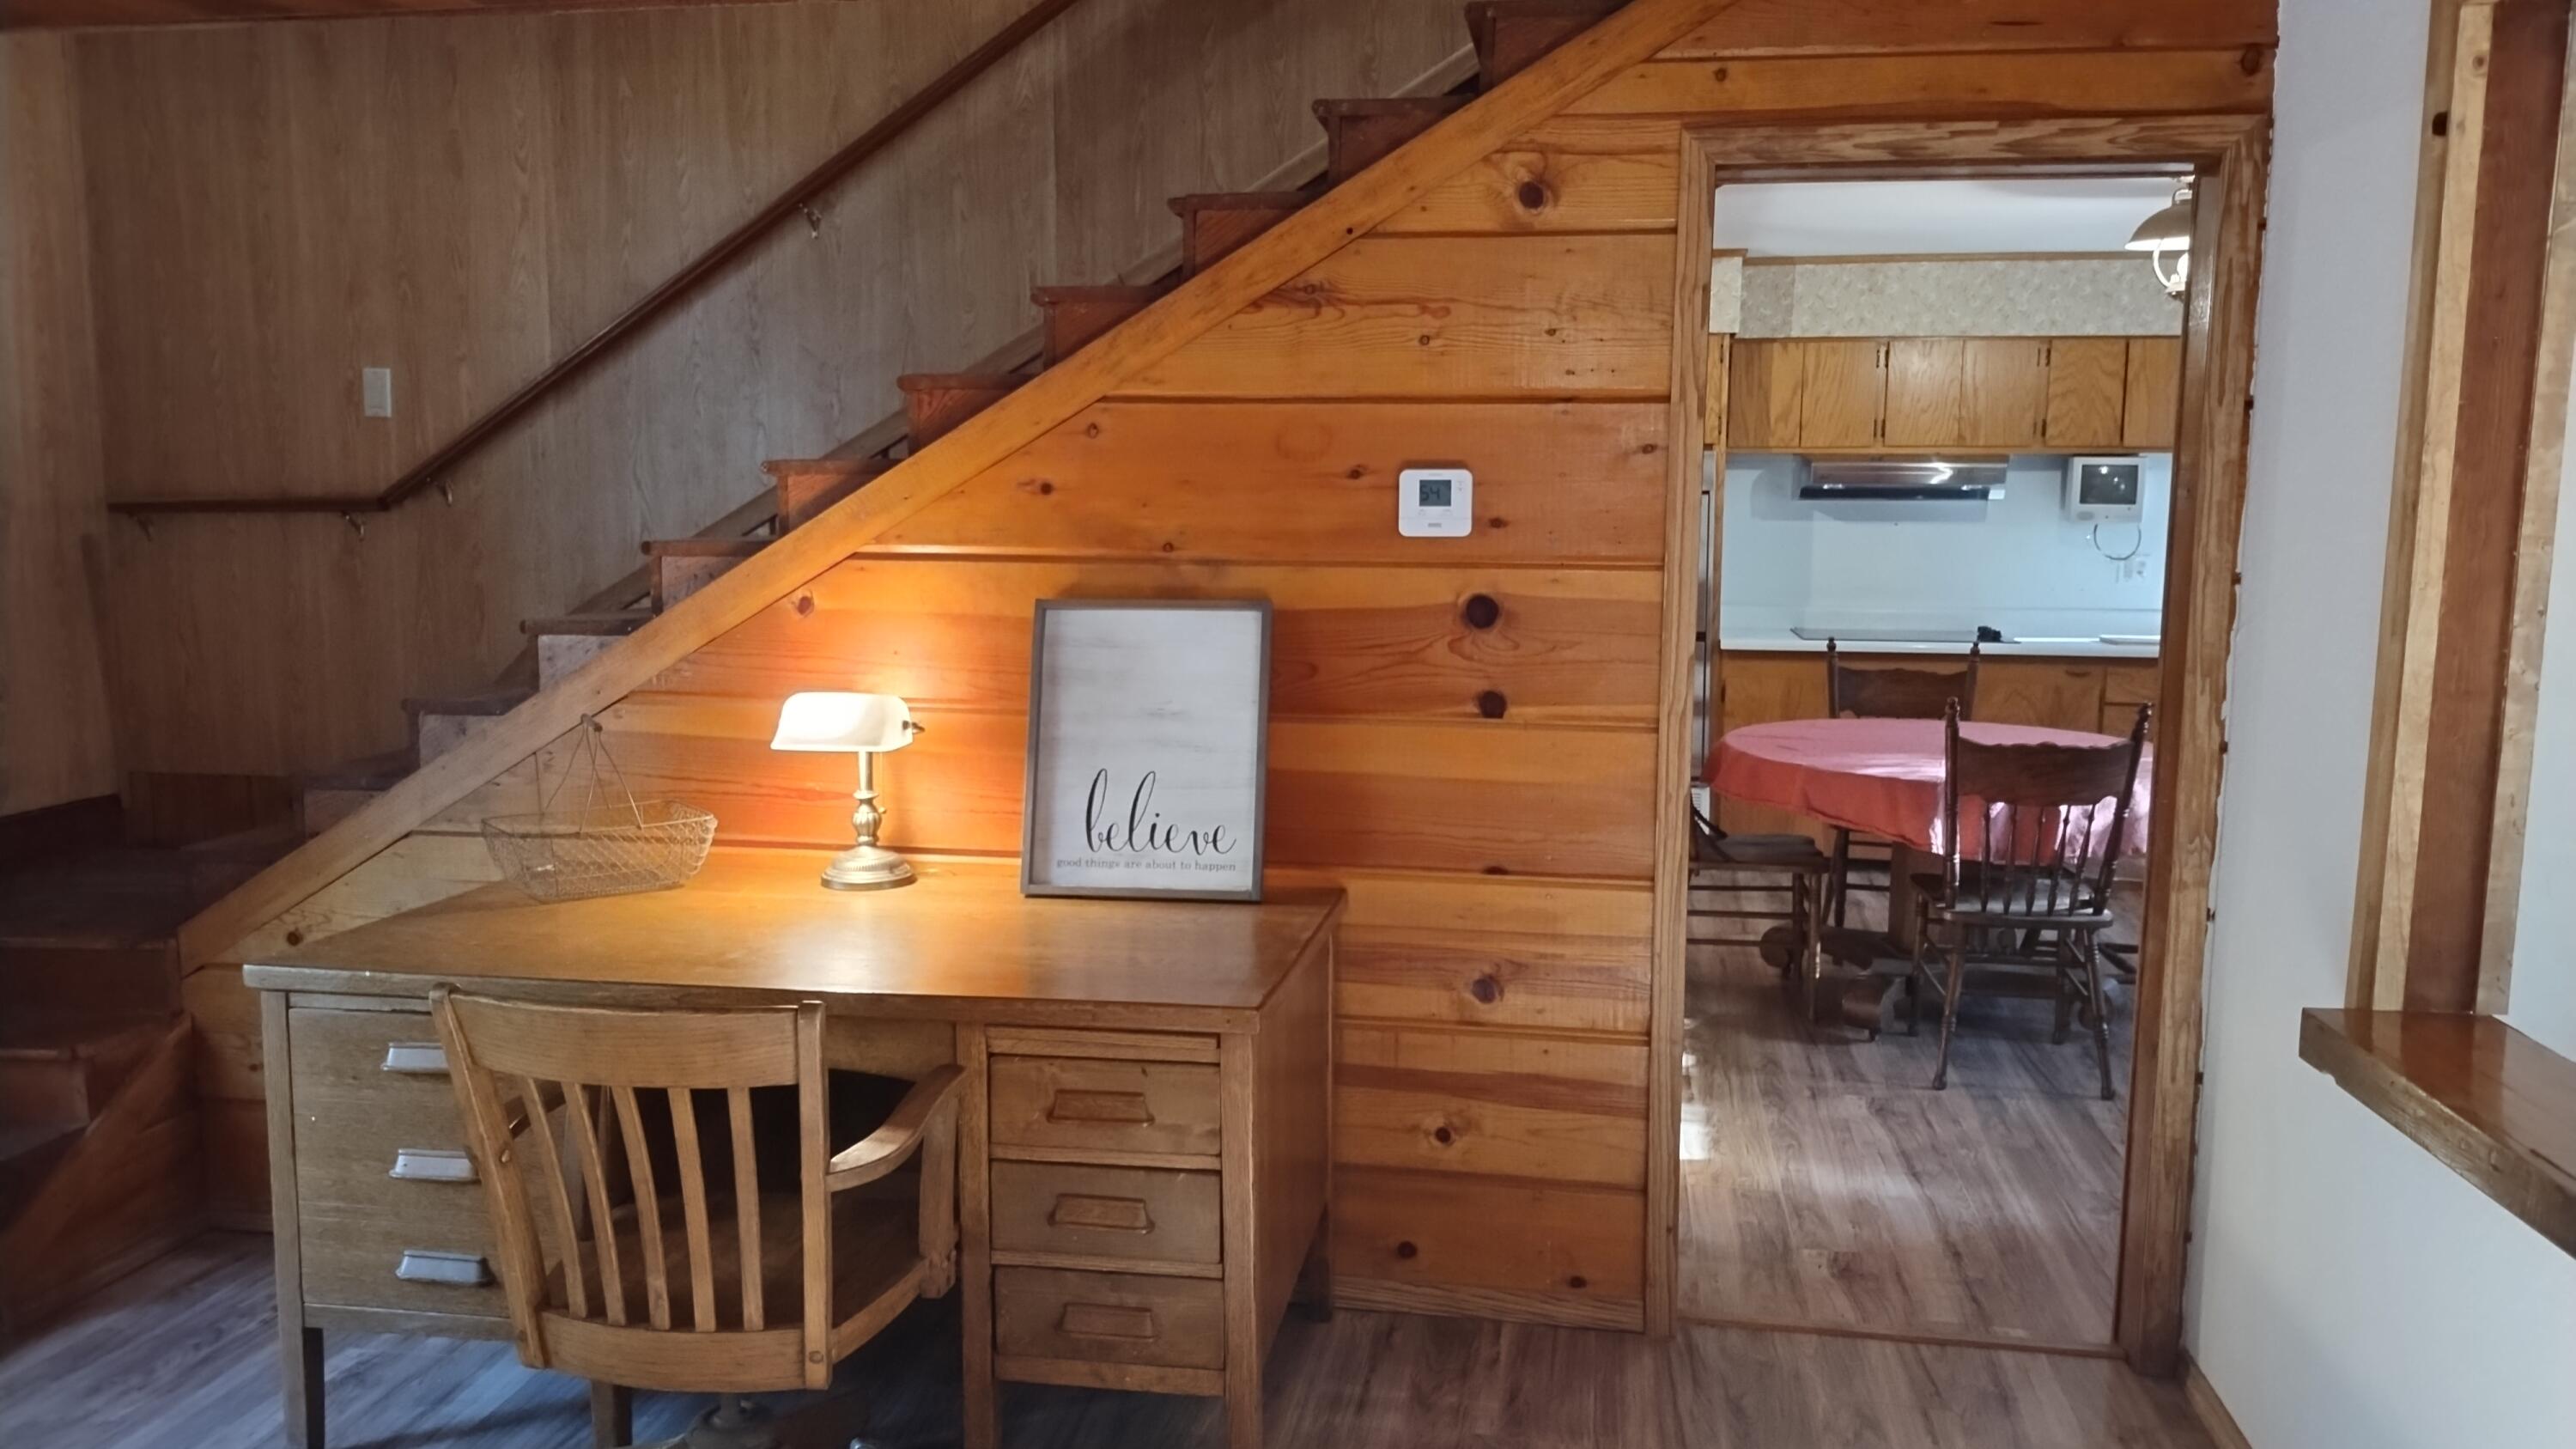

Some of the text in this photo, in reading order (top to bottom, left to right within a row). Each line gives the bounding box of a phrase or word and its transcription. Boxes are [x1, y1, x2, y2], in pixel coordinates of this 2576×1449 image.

[1085, 768, 1236, 855] believe
[1056, 857, 1082, 868] good
[1145, 859, 1176, 870] about
[1181, 861, 1192, 870] to
[1194, 860, 1236, 873] happen
